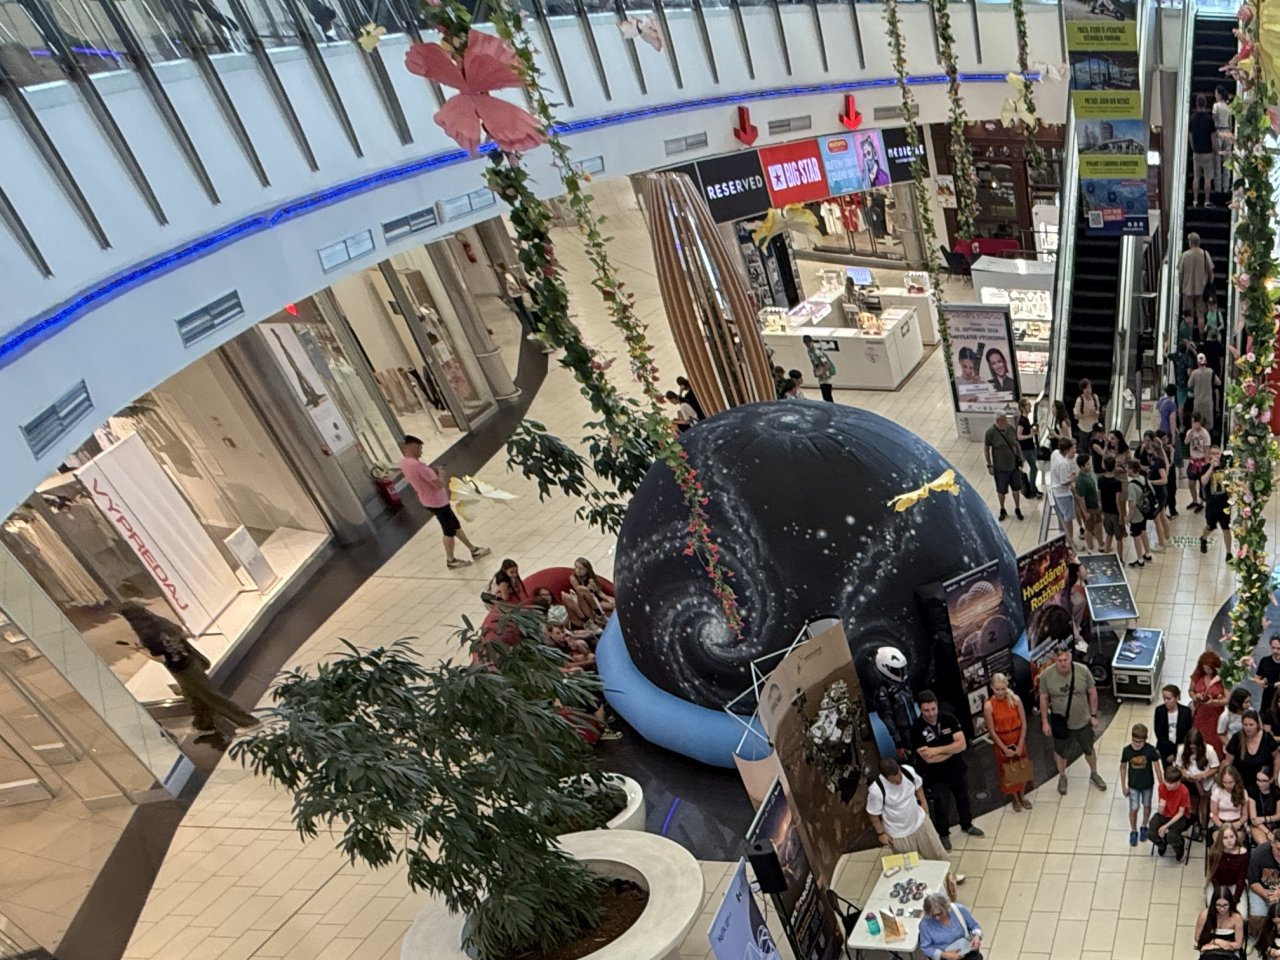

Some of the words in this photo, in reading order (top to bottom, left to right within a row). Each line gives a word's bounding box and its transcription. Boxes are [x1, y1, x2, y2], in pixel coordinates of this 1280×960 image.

[887, 144, 925, 158] MEDICNE
[707, 175, 763, 200] RESERVED
[783, 160, 801, 188] BIG
[799, 157, 821, 184] STAR
[93, 477, 190, 611] VÝPREDAJ
[1023, 560, 1068, 600] Hvezdáreň
